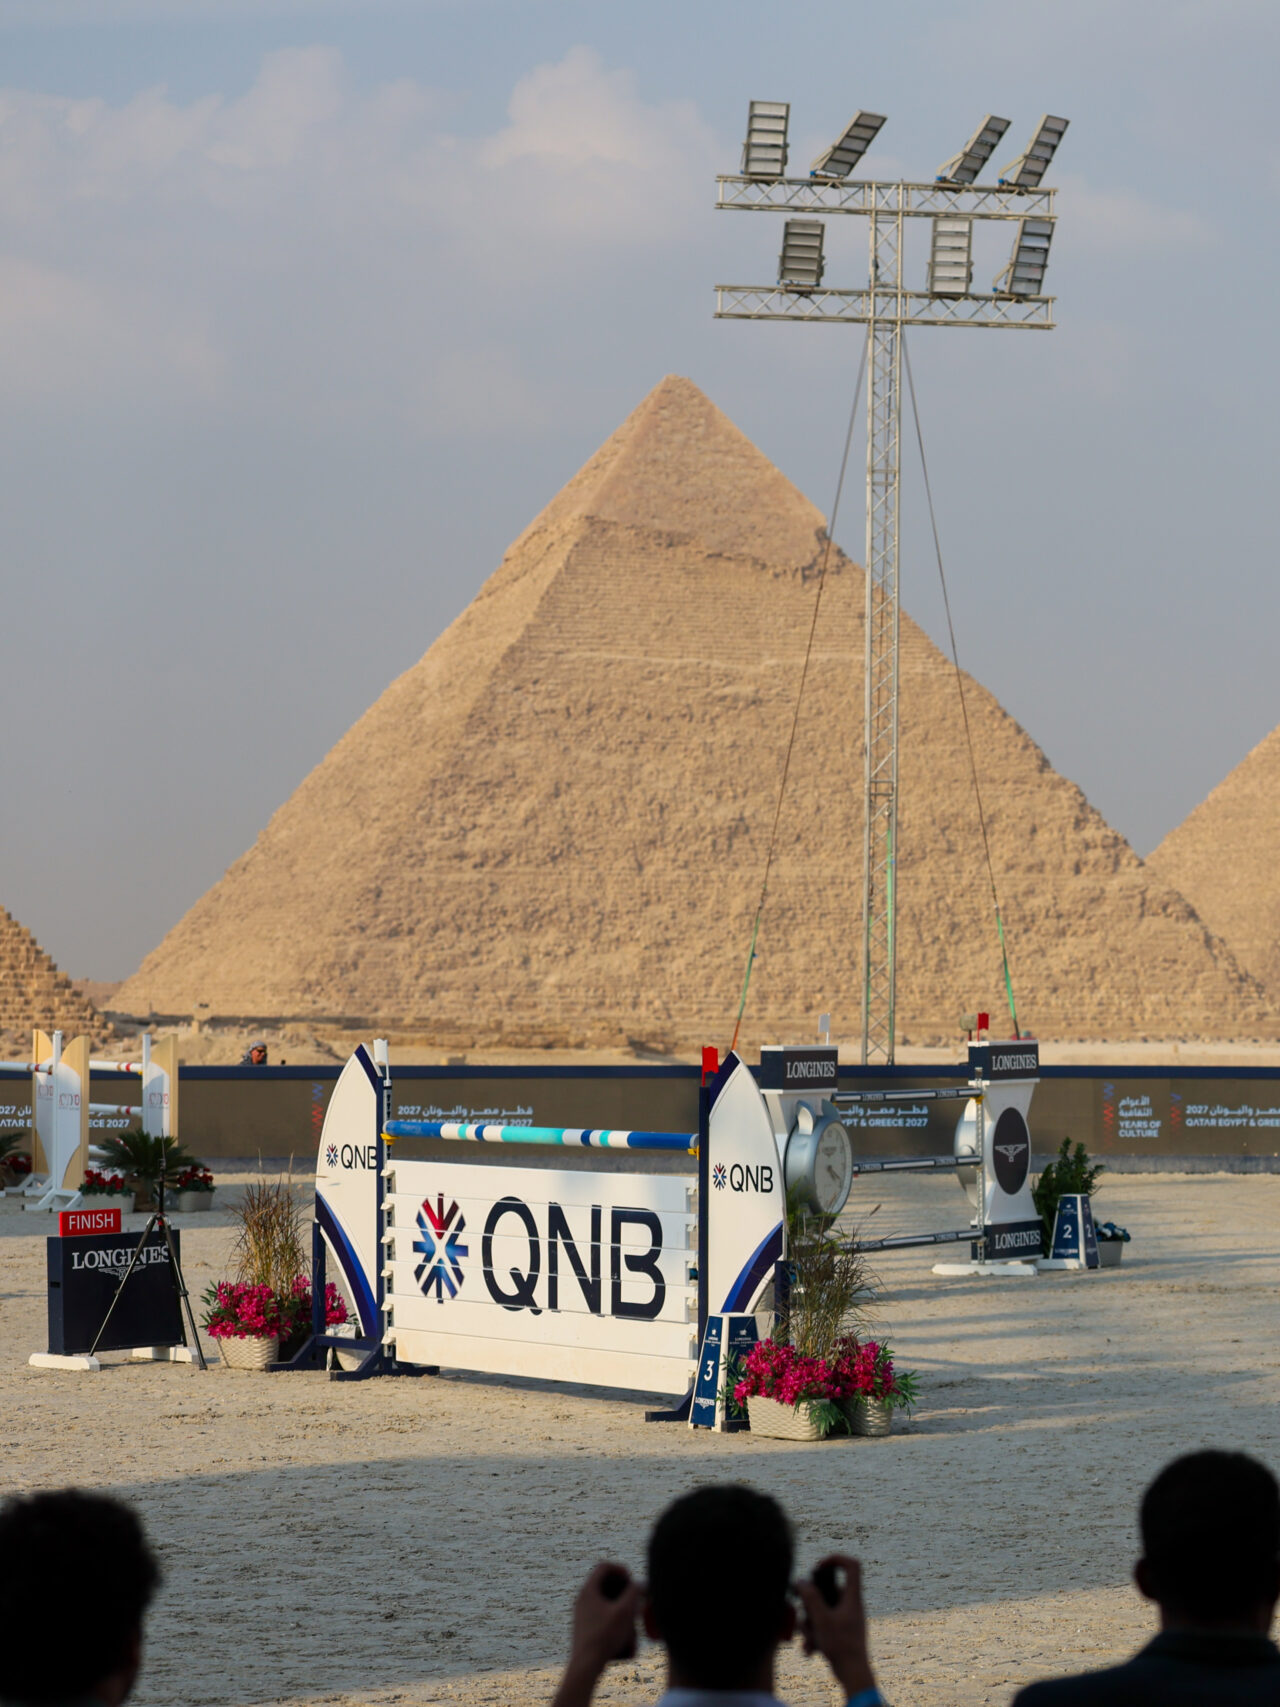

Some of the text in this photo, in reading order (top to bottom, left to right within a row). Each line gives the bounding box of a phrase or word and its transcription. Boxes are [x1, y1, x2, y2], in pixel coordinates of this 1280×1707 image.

[992, 1054, 1037, 1071] LONGINES
[786, 1061, 835, 1079] LONGINES
[0, 1105, 16, 1115] 027
[398, 1105, 421, 1115] 2027
[1186, 1105, 1208, 1115] 2027
[0, 1118, 25, 1127] ATAR
[106, 1118, 130, 1128] 2027
[841, 1118, 858, 1127] YPT
[868, 1118, 904, 1127] GREECE
[905, 1118, 928, 1127] 2027
[1119, 1120, 1162, 1128] YEARS OF
[1186, 1118, 1217, 1127] QATAR
[1218, 1118, 1247, 1127] EGYPT
[1249, 1118, 1256, 1127] &
[1118, 1129, 1159, 1138] CULTURE
[340, 1144, 377, 1170] QNB
[730, 1164, 774, 1193] QNB
[68, 1213, 114, 1230] FINISH
[1063, 1224, 1072, 1239] 2
[1086, 1224, 1093, 1238] 2
[995, 1229, 1041, 1250] LONGINES
[482, 1196, 666, 1322] QNB
[704, 1360, 715, 1381] 3
